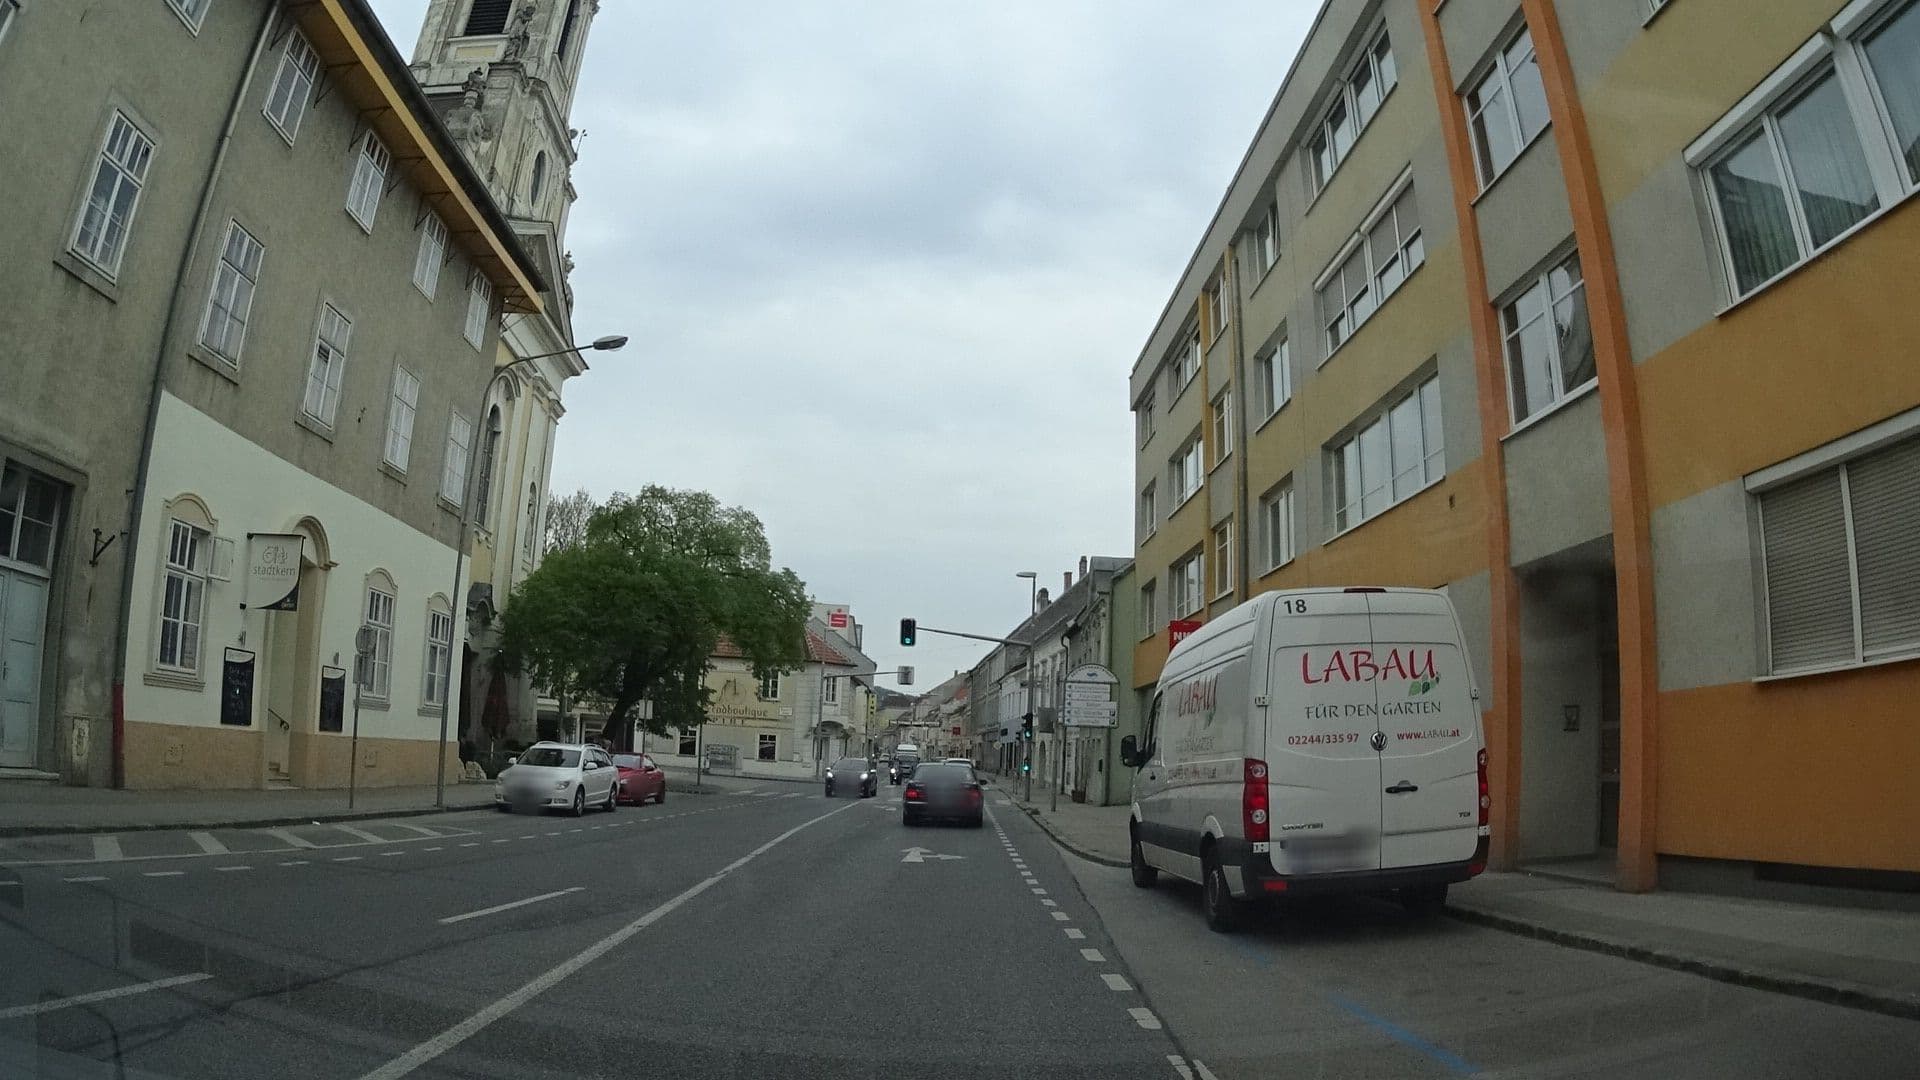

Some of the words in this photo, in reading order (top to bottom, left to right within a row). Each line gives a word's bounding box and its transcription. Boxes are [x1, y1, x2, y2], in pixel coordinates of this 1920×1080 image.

[252, 564, 297, 577] stadtkern
[1283, 599, 1308, 615] 18
[1302, 648, 1436, 684] LABAU
[1304, 703, 1340, 719] FÜR
[1344, 703, 1378, 717] DEN
[1382, 700, 1441, 716] GARTEN
[1287, 734, 1345, 745] 02244/335
[1346, 733, 1360, 743] 97
